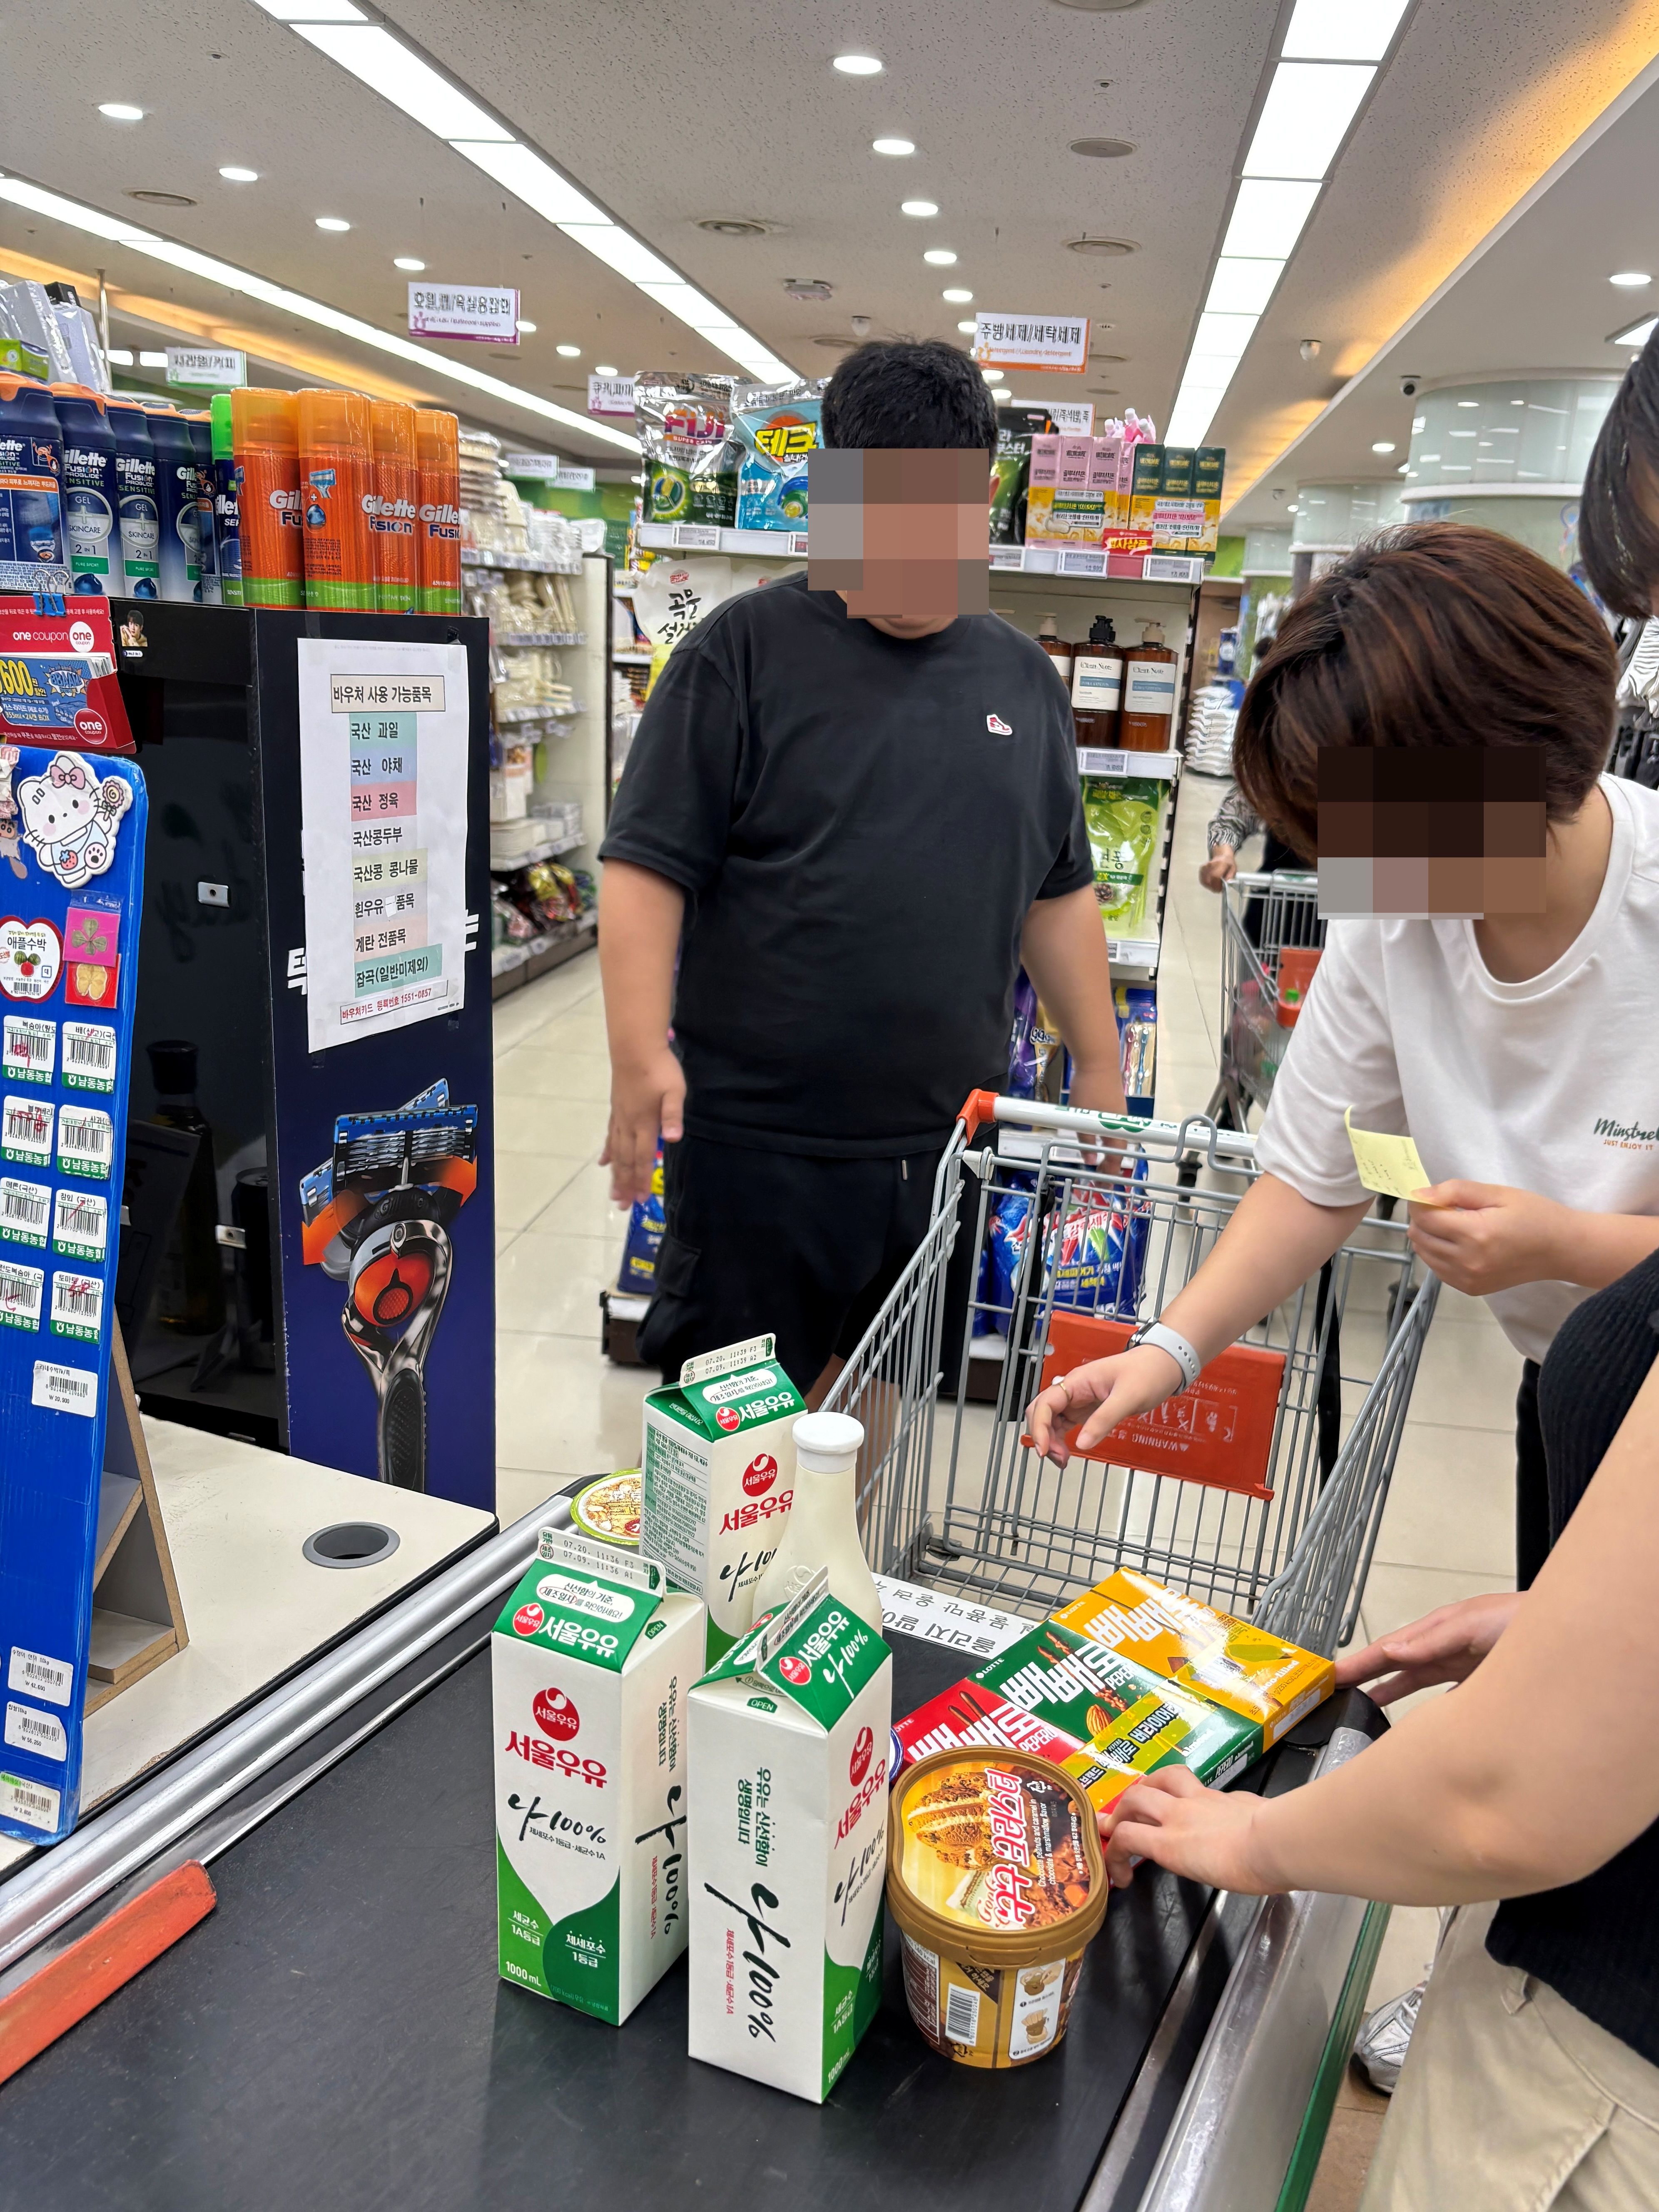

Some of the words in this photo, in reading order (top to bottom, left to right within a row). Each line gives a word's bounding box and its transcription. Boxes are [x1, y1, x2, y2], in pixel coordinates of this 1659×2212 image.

[64, 449, 107, 467] illette
[116, 458, 155, 476] Gillette
[75, 496, 91, 504] GEL
[269, 489, 302, 510] Gill
[419, 504, 460, 525] Gille
[69, 525, 101, 534] SKINCARE
[128, 531, 155, 539] SKINCARE
[76, 544, 82, 553] 2
[92, 545, 96, 554] 1
[136, 550, 142, 559] 2
[13, 631, 31, 640] one
[33, 631, 68, 643] coupon
[73, 631, 92, 640] one
[333, 685, 364, 703] 바우처
[368, 686, 389, 703] 사용
[392, 686, 432, 703] 가능품목
[80, 720, 102, 730] one
[351, 722, 371, 740] 국산
[378, 722, 399, 739] 과일
[351, 759, 371, 776] 국산
[381, 757, 403, 774] 야채
[352, 795, 372, 812] 국산
[379, 792, 399, 810] 정육
[353, 827, 403, 847] 국산콩두부
[354, 863, 383, 883] 국산콩
[389, 859, 418, 878] 콩나물
[355, 899, 384, 919] 흰우유
[396, 893, 415, 910] 품목
[7, 937, 47, 952] 애플수박
[378, 928, 406, 948] 전품목
[356, 956, 428, 989] 잡곡(일반미제외)
[17, 1068, 52, 1083] 남동농협
[1603, 1139, 1618, 1148] JUST
[1620, 1141, 1642, 1150] ENJOY
[61, 1193, 73, 1202] 참외
[12, 1230, 46, 1247] 남동농협
[67, 1243, 101, 1259] 남동농협
[5, 1313, 39, 1330] 남동농협
[730, 1349, 747, 1359] 11:39
[730, 1357, 747, 1367] 11:39
[738, 1392, 795, 1422] 서울우유
[720, 1415, 739, 1425] 서울우유
[1131, 1434, 1178, 1450] WARNING
[744, 1467, 777, 1487] 서울우유
[719, 1489, 794, 1535] 서울우유
[564, 1540, 590, 1555] 07.20.
[597, 1551, 619, 1564] 11:36
[625, 1559, 634, 1569] F3
[564, 1550, 590, 1565] 07.09.
[596, 1562, 619, 1575] 11:36
[625, 1571, 633, 1579] A1
[564, 1582, 595, 1599] 신선함의
[596, 1592, 613, 1606] 기준,
[893, 1589, 935, 1607] 올려
[515, 1613, 541, 1629] 서울우유
[944, 1602, 1009, 1630] 물품만
[538, 1616, 619, 1658] 서울우유
[647, 1621, 664, 1638] OPEN
[798, 1611, 850, 1667] 서울우유
[924, 1623, 996, 1654] 올리지
[788, 1661, 805, 1681] 서울우유
[982, 1657, 1004, 1674] LOTTE
[999, 1641, 1127, 1711] 빼빼로
[750, 1699, 775, 1711] OPEN
[535, 1705, 578, 1730] 서울우유
[895, 1718, 914, 1732] OTTE
[1021, 1726, 1059, 1752] PEPERO
[505, 1730, 608, 1789] 서울우유
[851, 1742, 872, 1779] 서울우유
[756, 1767, 771, 1809] 우유는
[737, 1779, 752, 1845] 생명입니다
[834, 1758, 886, 1850] 서울우유
[507, 1793, 607, 1844] 나100%
[1030, 1805, 1039, 1825] caramel
[755, 1811, 771, 1867] 신선함이
[1032, 1826, 1041, 1836] and
[1041, 1818, 1052, 1852] marshmallow
[1035, 1837, 1044, 1858] peanuts
[1036, 1859, 1046, 1887] Chocolate
[1046, 1858, 1056, 1885] chocolate
[512, 1910, 539, 1930] 세균수
[511, 1924, 541, 1946] 1A등급
[565, 1933, 606, 1954] 체세포수
[573, 1951, 598, 1968] 1등급
[924, 1952, 936, 1965] kcal
[506, 1960, 528, 1980] 1000
[529, 1974, 542, 1987] mL
[828, 2057, 843, 2083] 1000
